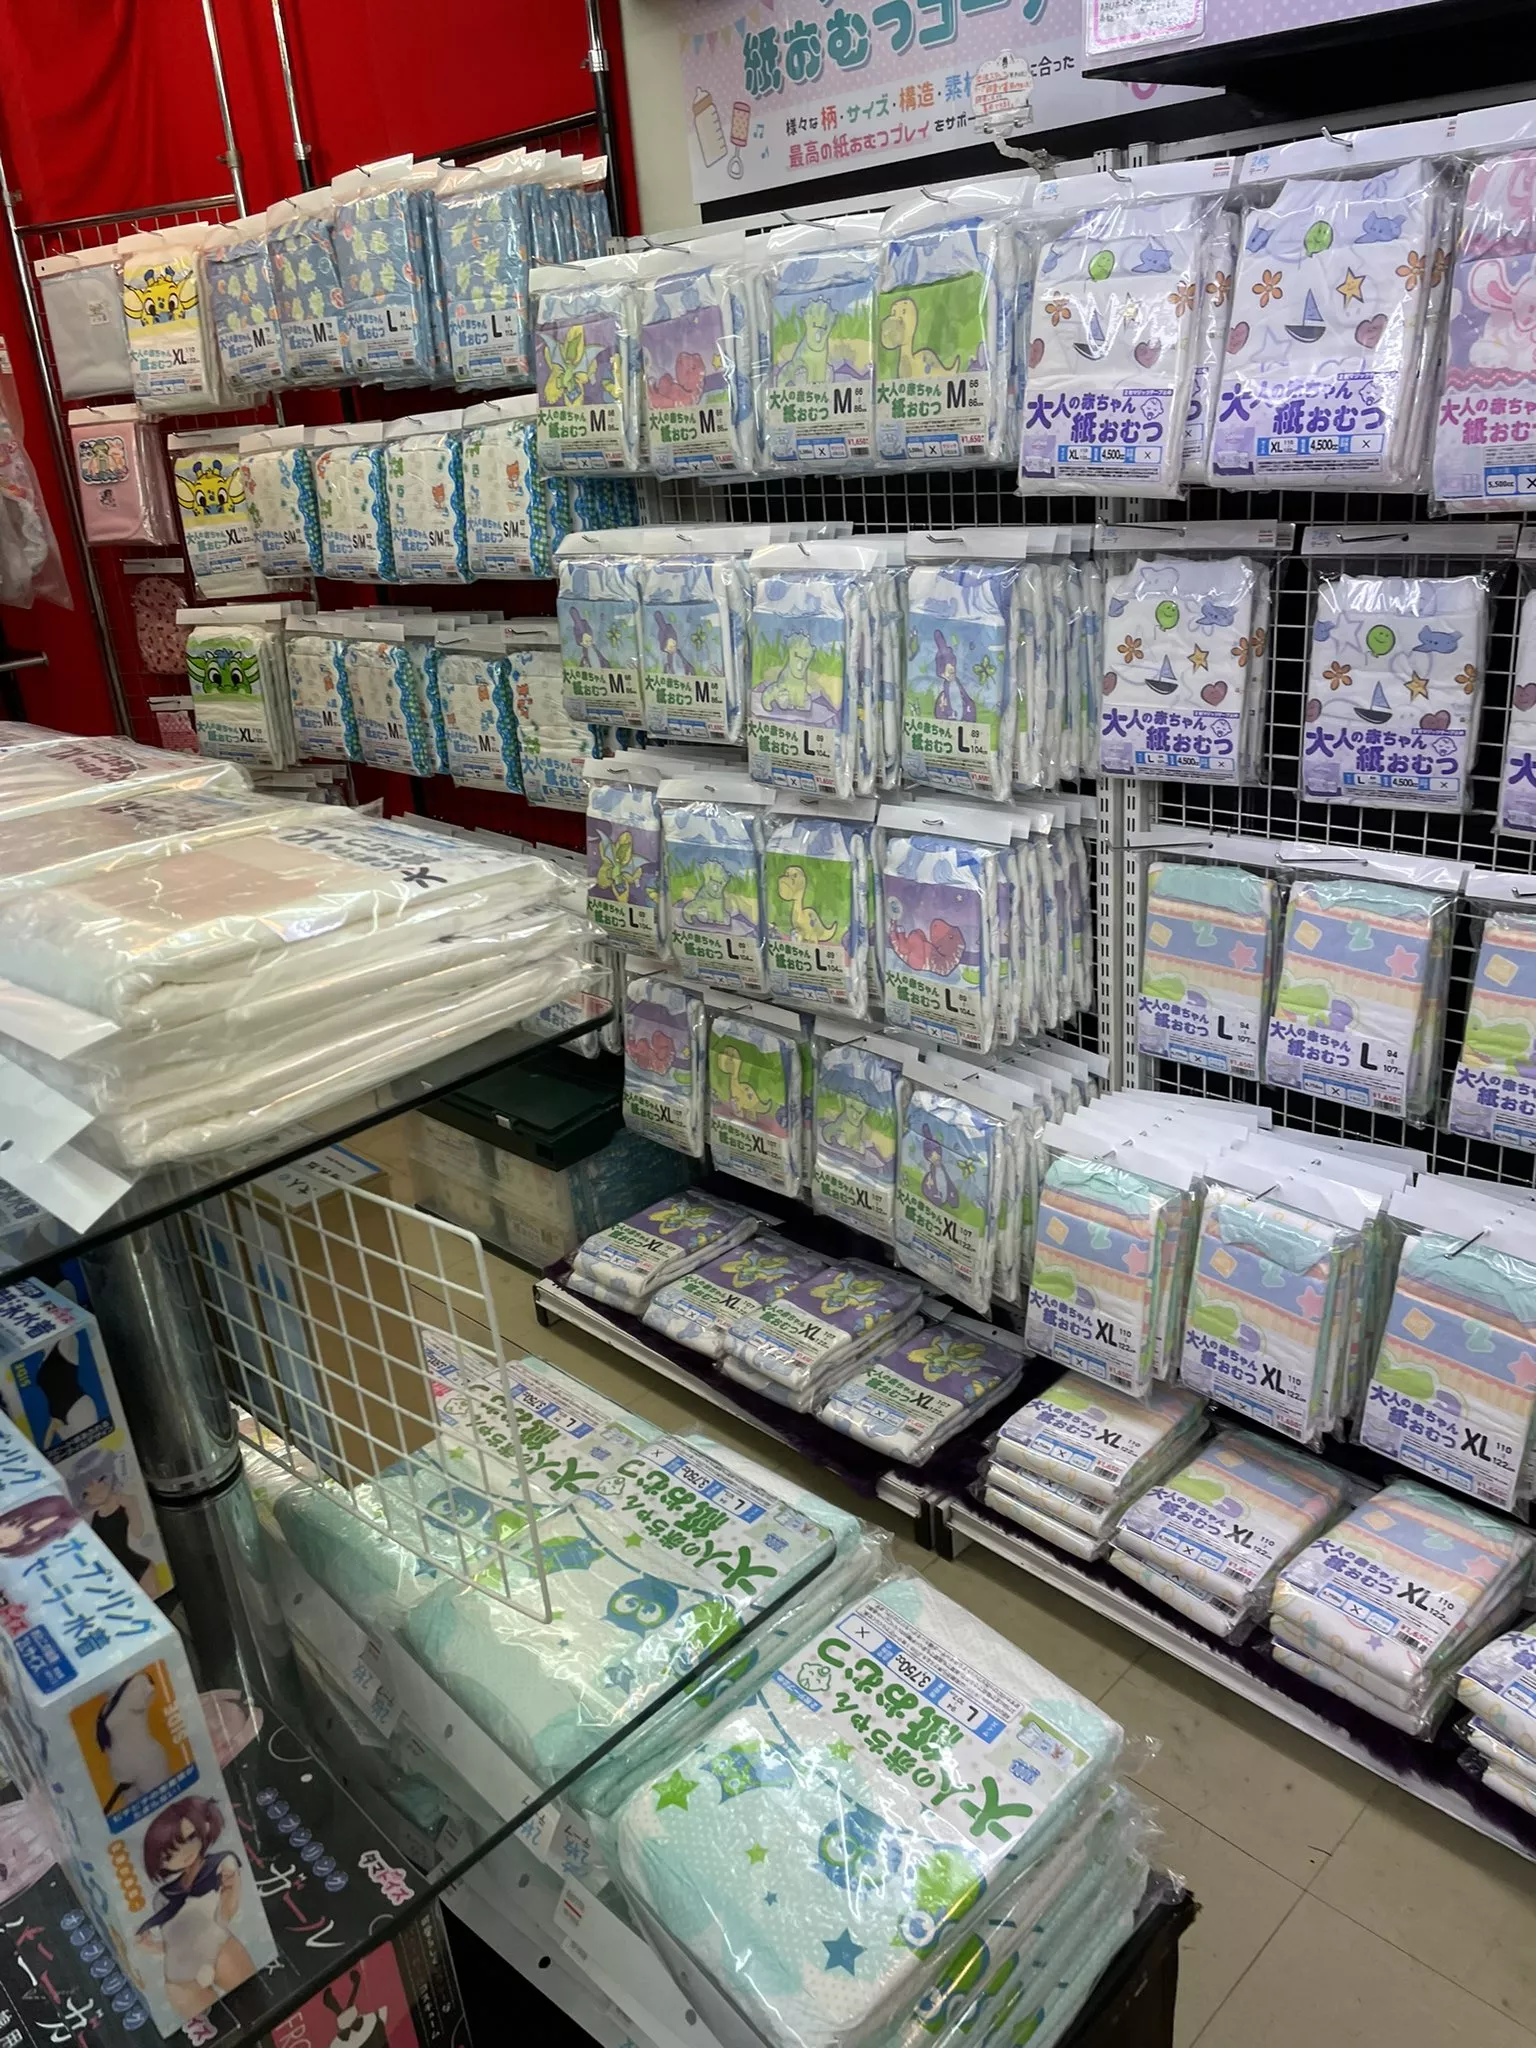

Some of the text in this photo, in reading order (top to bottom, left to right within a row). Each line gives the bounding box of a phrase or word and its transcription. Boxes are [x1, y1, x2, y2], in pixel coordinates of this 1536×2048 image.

[313, 323, 327, 343] M
[387, 310, 398, 332] L
[491, 315, 502, 337] L
[252, 329, 266, 347] M
[173, 349, 187, 365] XL
[834, 388, 852, 414] M
[947, 381, 966, 408] M
[590, 409, 606, 432] M
[699, 409, 715, 434] M
[1026, 391, 1136, 431] 大人の赤ちゃん
[1070, 412, 1162, 445] 紙おむつ
[1463, 415, 1536, 446] 紙おむ
[1069, 447, 1079, 461] XL
[1270, 438, 1284, 454] XL
[225, 529, 243, 545] XL
[609, 674, 624, 694] M
[695, 681, 710, 703] M
[323, 711, 333, 727] M
[388, 722, 399, 739] M
[1102, 708, 1206, 737] 大人の赤ちゃん
[240, 727, 255, 743] XL
[478, 735, 490, 752] M
[804, 730, 815, 756] L
[958, 726, 970, 753] L
[1146, 726, 1233, 756] 紙おむつ
[1305, 727, 1427, 757] 大人の赤ちゃん
[1147, 753, 1154, 764] L
[1356, 745, 1458, 775] 紙おむつ
[1357, 774, 1365, 785] L
[629, 908, 638, 928] L
[727, 938, 738, 960] L
[815, 948, 828, 971] L
[945, 989, 958, 1013] L
[1139, 998, 1209, 1025] 大人の赤ちゃん
[1154, 1012, 1209, 1038] 紙おむつ
[1217, 1015, 1233, 1040] L
[1269, 1021, 1351, 1053] 大人の赤ちゃん
[1287, 1039, 1350, 1068] 紙おむつ
[1360, 1042, 1378, 1071] L
[660, 1105, 674, 1124] XL
[752, 1134, 768, 1154] XL
[856, 1190, 872, 1211] XL
[943, 1220, 960, 1243] XL
[643, 1238, 663, 1252] XL
[720, 1293, 742, 1309] XL
[1028, 1290, 1093, 1329] 大人の赤ちゃん
[798, 1323, 820, 1340] XL
[1043, 1307, 1093, 1341] 紙おむつ
[1095, 1319, 1117, 1347] XL
[1185, 1329, 1258, 1372] 大人の赤ちゃん
[1200, 1348, 1257, 1385] 紙おむつ
[1260, 1365, 1287, 1394] XL
[911, 1390, 937, 1410] XL
[1369, 1385, 1457, 1435] 大人の赤ちゃん
[1095, 1428, 1122, 1449] XL
[1388, 1407, 1457, 1450] 紙おむつ
[1460, 1428, 1492, 1462] XL
[616, 1457, 731, 1538] 紙おむつ
[622, 1493, 777, 1595] 大人の赤ちゃん
[1223, 1524, 1255, 1549] XL
[1311, 1538, 1400, 1587] 大人の赤ちゃん
[1323, 1554, 1397, 1595] 紙おむつ
[1397, 1582, 1432, 1611] XL
[895, 1653, 931, 1688] 3,750cc
[817, 1637, 963, 1763] 紙おむつ
[967, 1705, 979, 1721] L
[833, 1688, 1033, 1843] 大人の赤ちゃん
